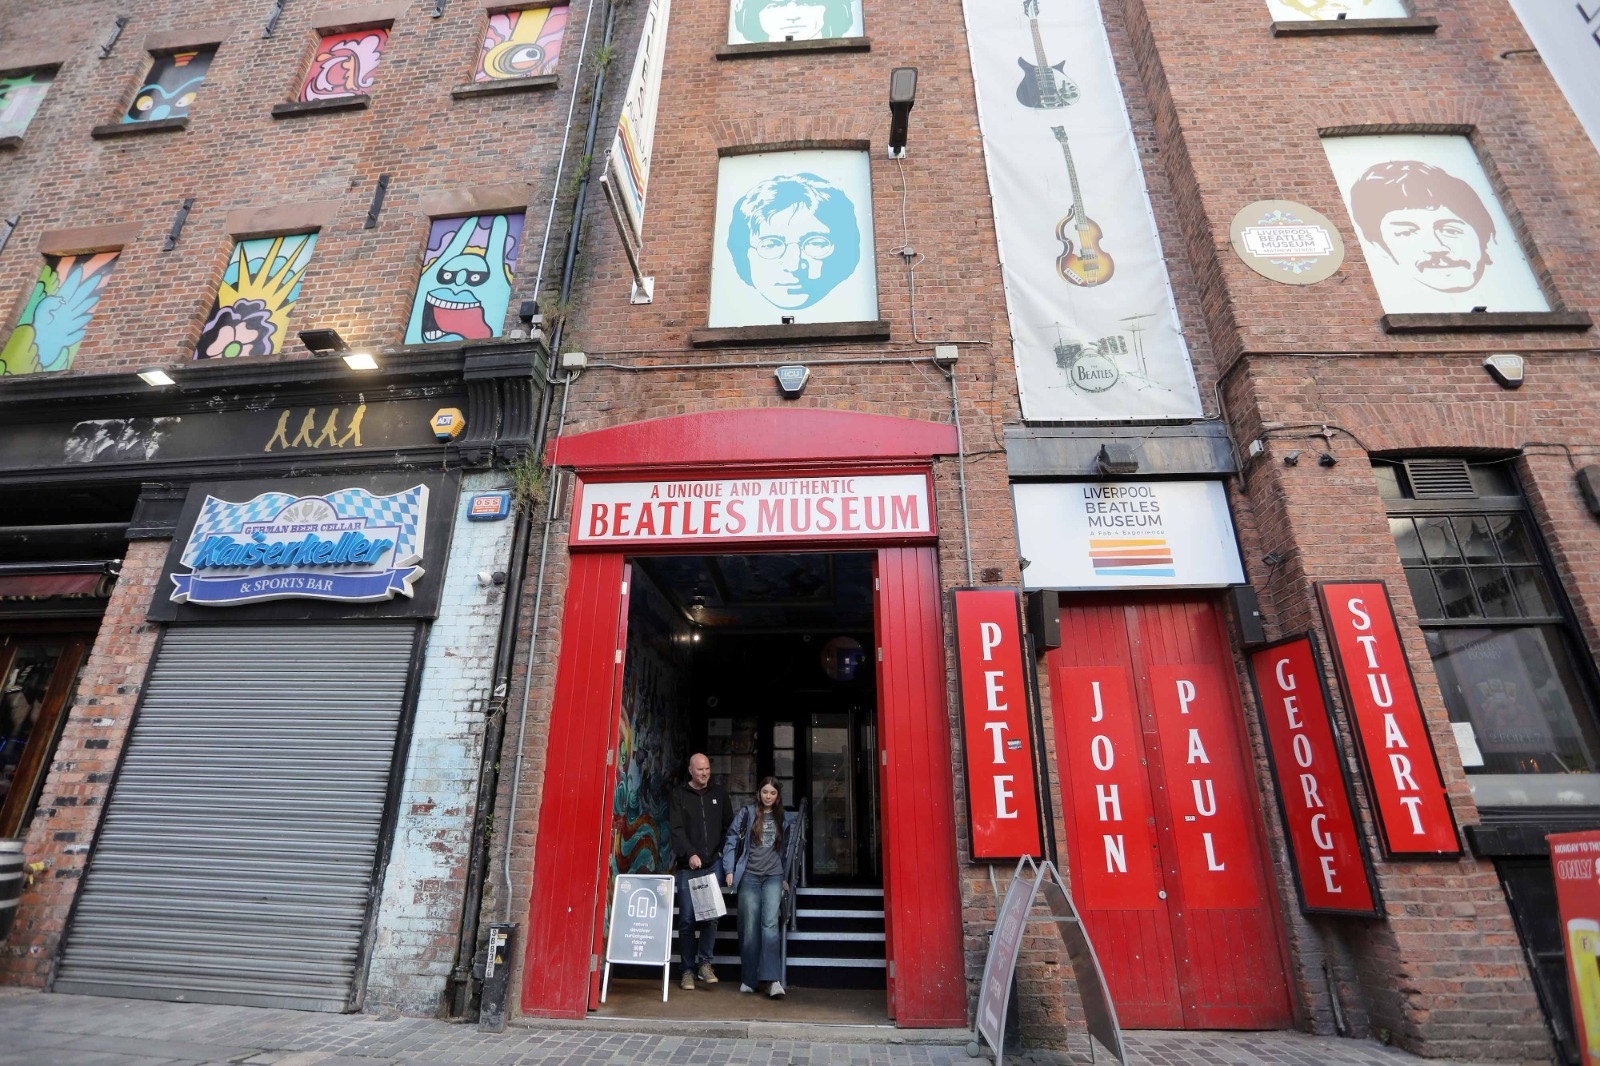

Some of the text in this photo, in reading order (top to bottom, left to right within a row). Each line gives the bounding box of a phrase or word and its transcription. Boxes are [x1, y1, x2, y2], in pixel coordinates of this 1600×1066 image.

[1077, 365, 1114, 381] BEATLES
[437, 416, 452, 425] ADT
[651, 479, 855, 499] A UNIQUE AND AUTHENTIC
[1083, 486, 1156, 499] LIVERPOOL
[588, 495, 920, 537] BEATLES MUSEUM
[1086, 501, 1160, 514] BEATLES
[245, 522, 362, 535] GERMAN BEER CELLAR
[1088, 515, 1162, 527] MUSEUM
[192, 531, 394, 569] Kaiserkeller
[240, 577, 333, 593] & SPORTS BAR
[980, 622, 1018, 819] PETE
[1347, 598, 1426, 835] STUART
[1091, 681, 1128, 873] JOHN
[1175, 680, 1225, 871] PAUL
[1275, 658, 1342, 893] GEORGE
[1554, 843, 1579, 854] MONDAY
[1579, 842, 1588, 852] TO
[1557, 858, 1592, 880] ONLY
